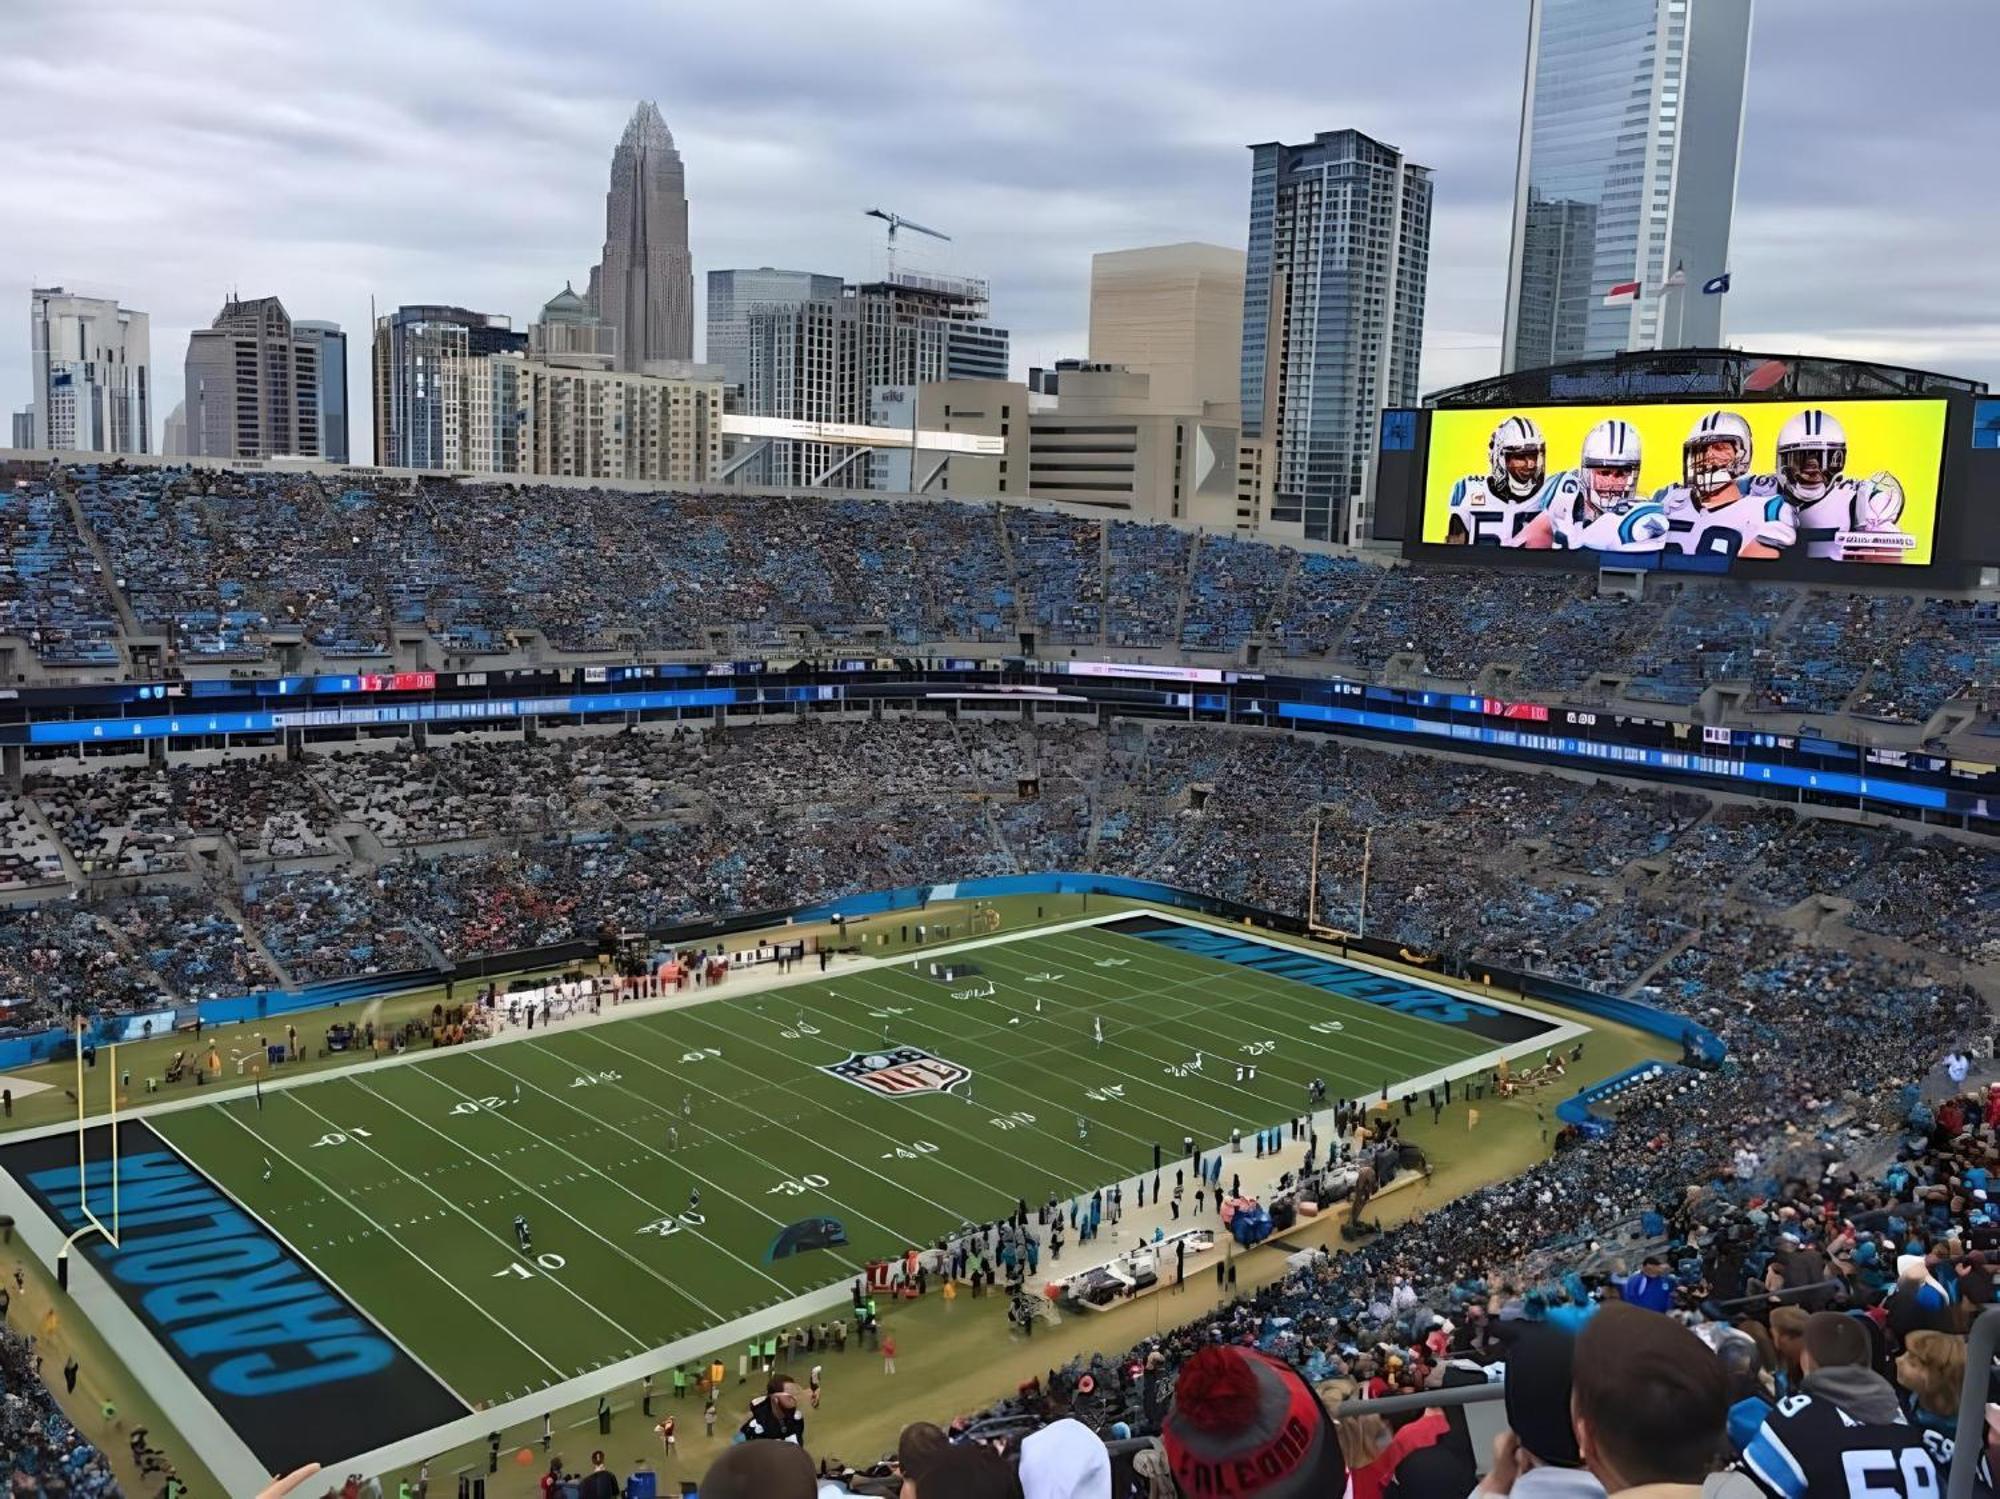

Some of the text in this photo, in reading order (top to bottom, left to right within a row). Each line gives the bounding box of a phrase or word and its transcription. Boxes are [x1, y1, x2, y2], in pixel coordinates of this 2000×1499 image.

[868, 1062, 956, 1092] NFL
[26, 1151, 395, 1396] CAROLINA
[507, 1252, 566, 1279] 10
